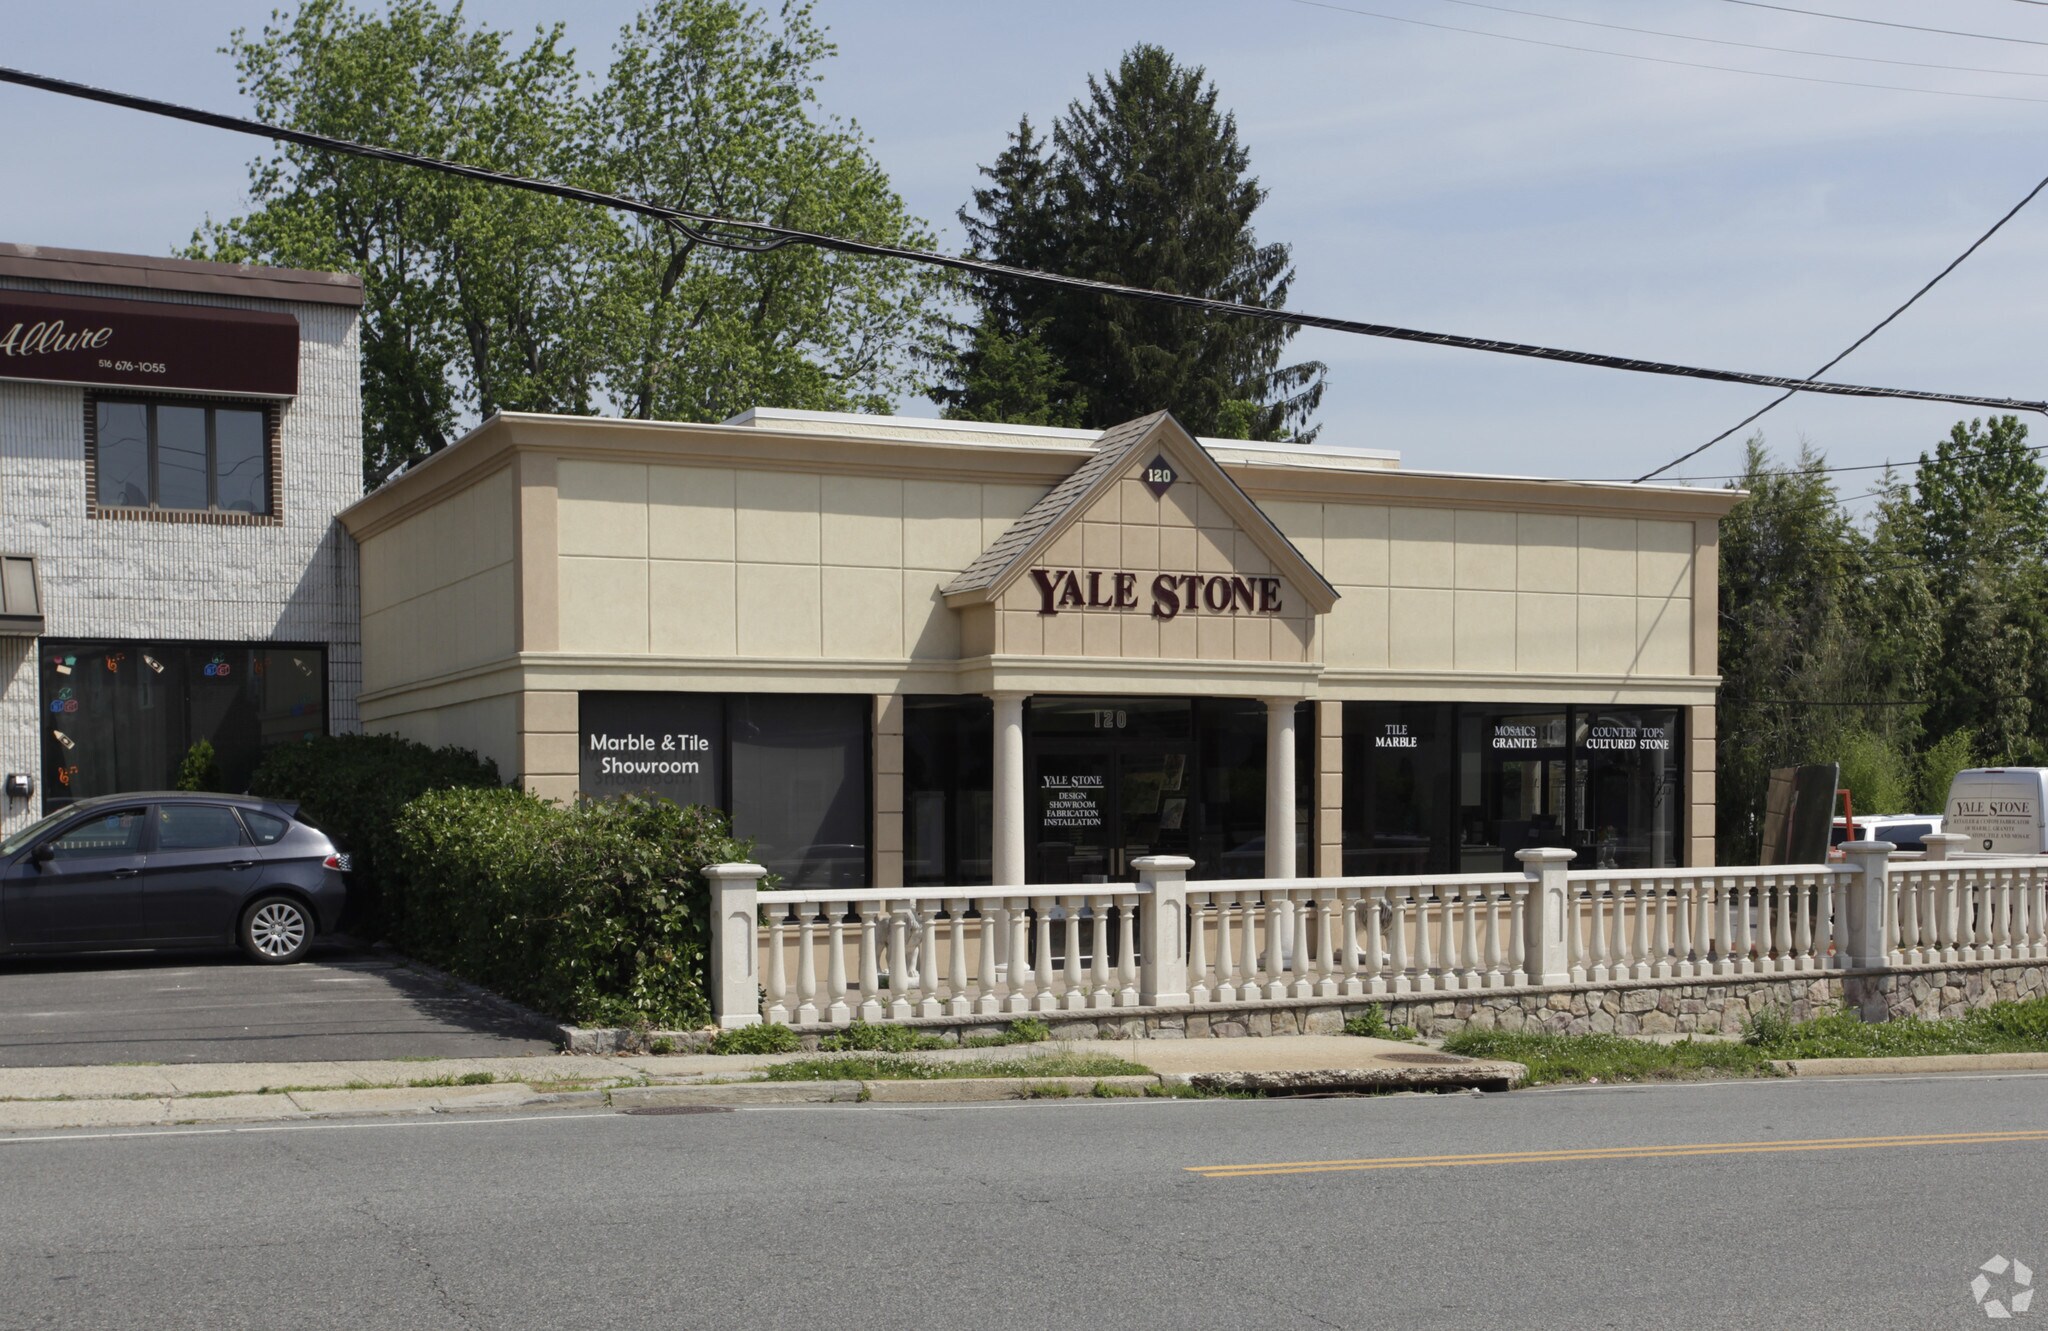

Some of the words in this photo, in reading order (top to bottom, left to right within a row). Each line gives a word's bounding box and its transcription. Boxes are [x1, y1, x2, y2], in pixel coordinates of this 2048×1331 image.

[0, 320, 113, 356] Allure
[98, 359, 113, 368] 516
[114, 360, 167, 374] 676-1055
[1148, 468, 1171, 483] 120
[1031, 569, 1139, 615] YALE
[1152, 574, 1283, 619] STONE
[1094, 710, 1127, 729] 120
[1385, 724, 1408, 735] TILE
[1494, 725, 1536, 737] MOSAICS
[1592, 727, 1638, 738] COUNTER
[1641, 727, 1665, 738] TOPS
[590, 733, 656, 751] Marble
[661, 734, 676, 751] &
[677, 734, 709, 751] Tile
[1375, 736, 1418, 748] MARBLE
[1492, 737, 1538, 749] GRANITE
[1586, 738, 1636, 750] CULTURED
[1639, 739, 1670, 750] STONE
[601, 757, 700, 774] Showroom
[1043, 775, 1069, 788] YALE
[1071, 775, 1103, 788] STONE
[1058, 792, 1087, 800] DESIGN
[1049, 801, 1096, 809] SHOWROOM
[1957, 801, 1985, 816] YALE
[1989, 801, 2030, 817] STONE
[1043, 818, 1101, 826] INSTALLATION
